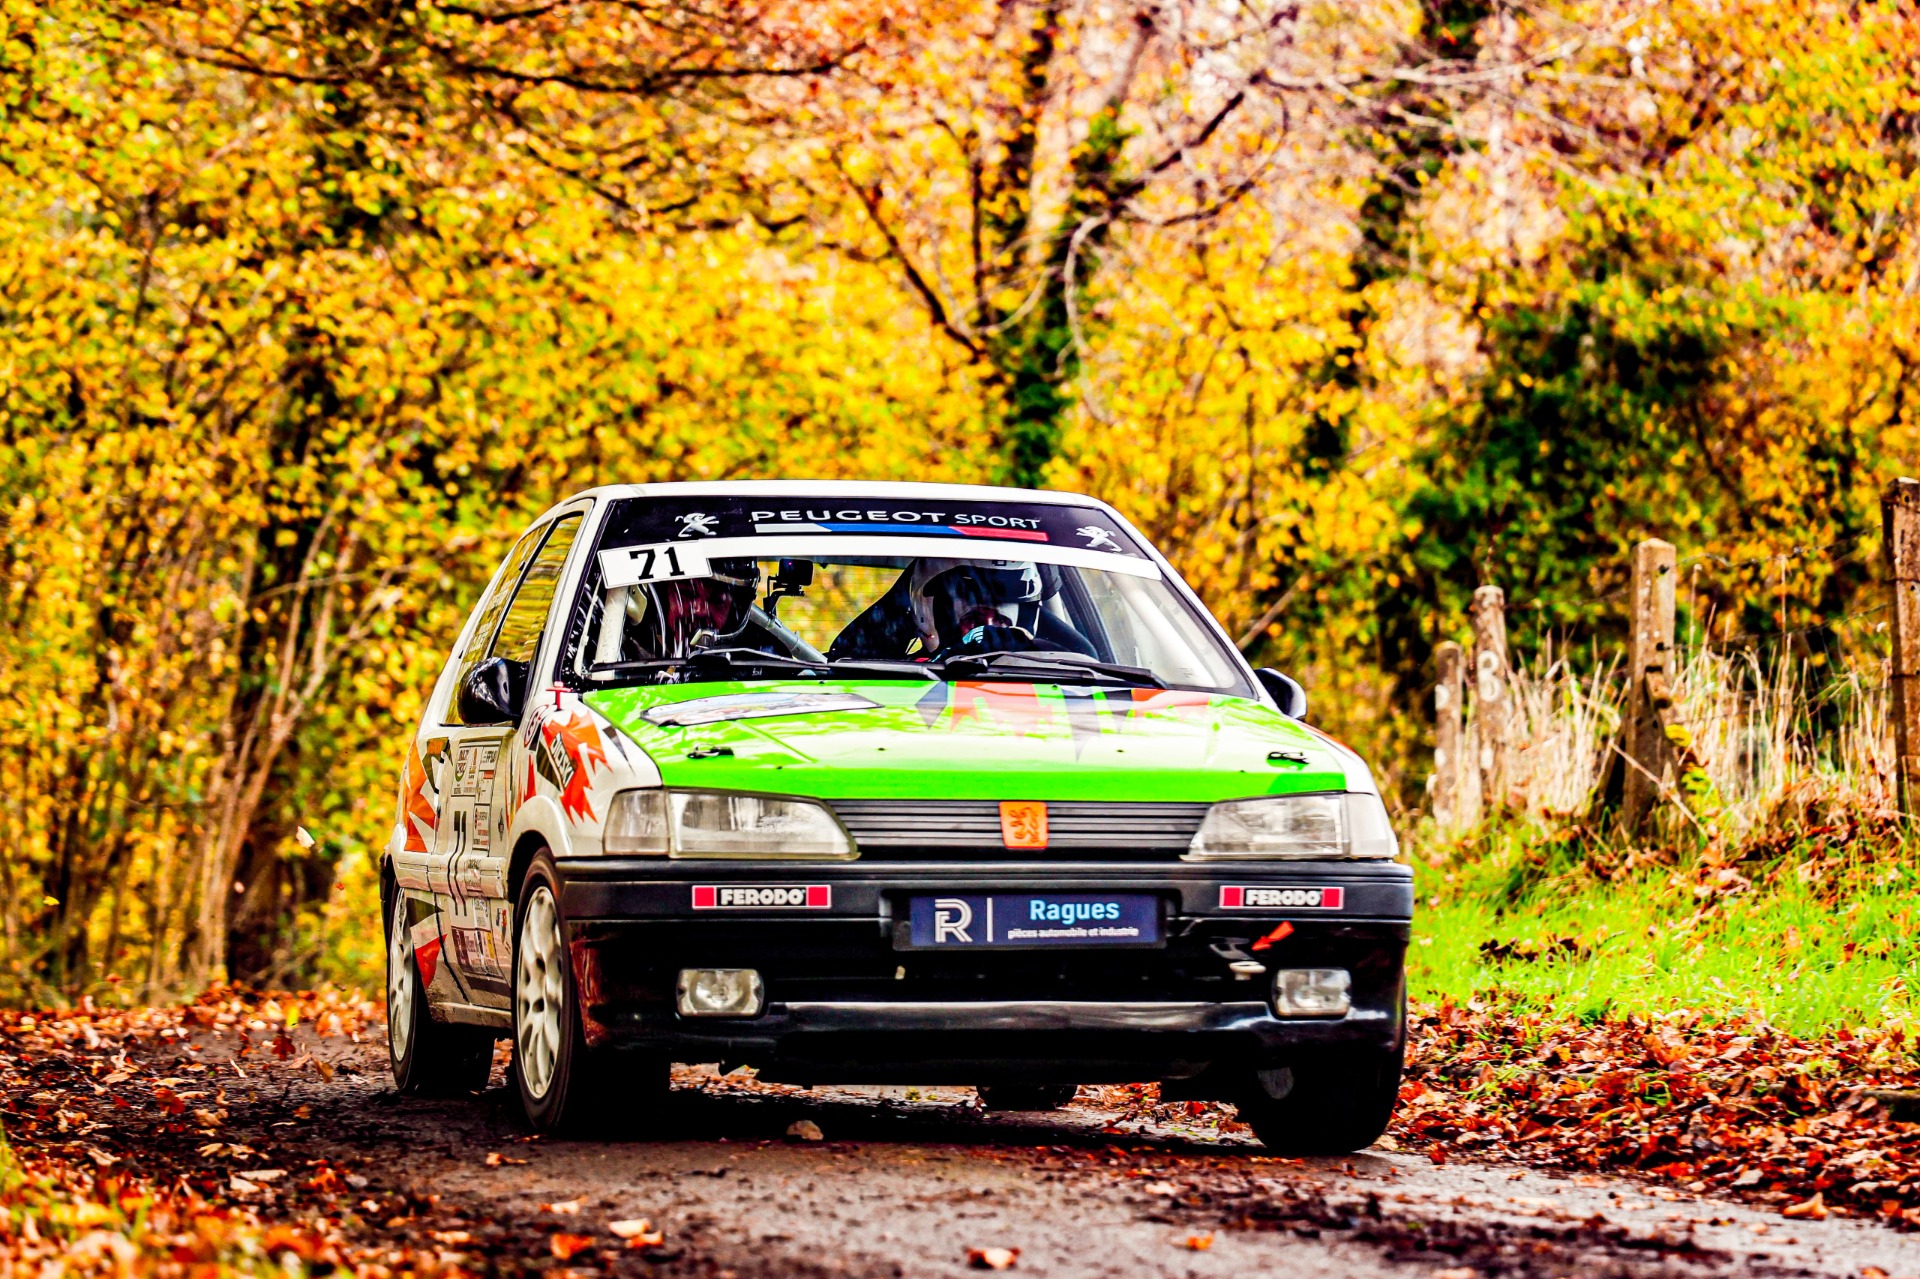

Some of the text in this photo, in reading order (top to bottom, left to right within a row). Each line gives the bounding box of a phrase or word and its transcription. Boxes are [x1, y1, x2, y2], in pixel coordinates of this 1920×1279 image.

[751, 510, 1041, 530] PEUGEOT SPORT
[629, 546, 685, 580] 71
[720, 888, 804, 905] FERODO
[1246, 889, 1321, 906] FERODO
[1029, 899, 1120, 925] Ragues
[1038, 927, 1088, 938] automobile
[1088, 928, 1099, 938] et
[1099, 926, 1140, 937] industrie
